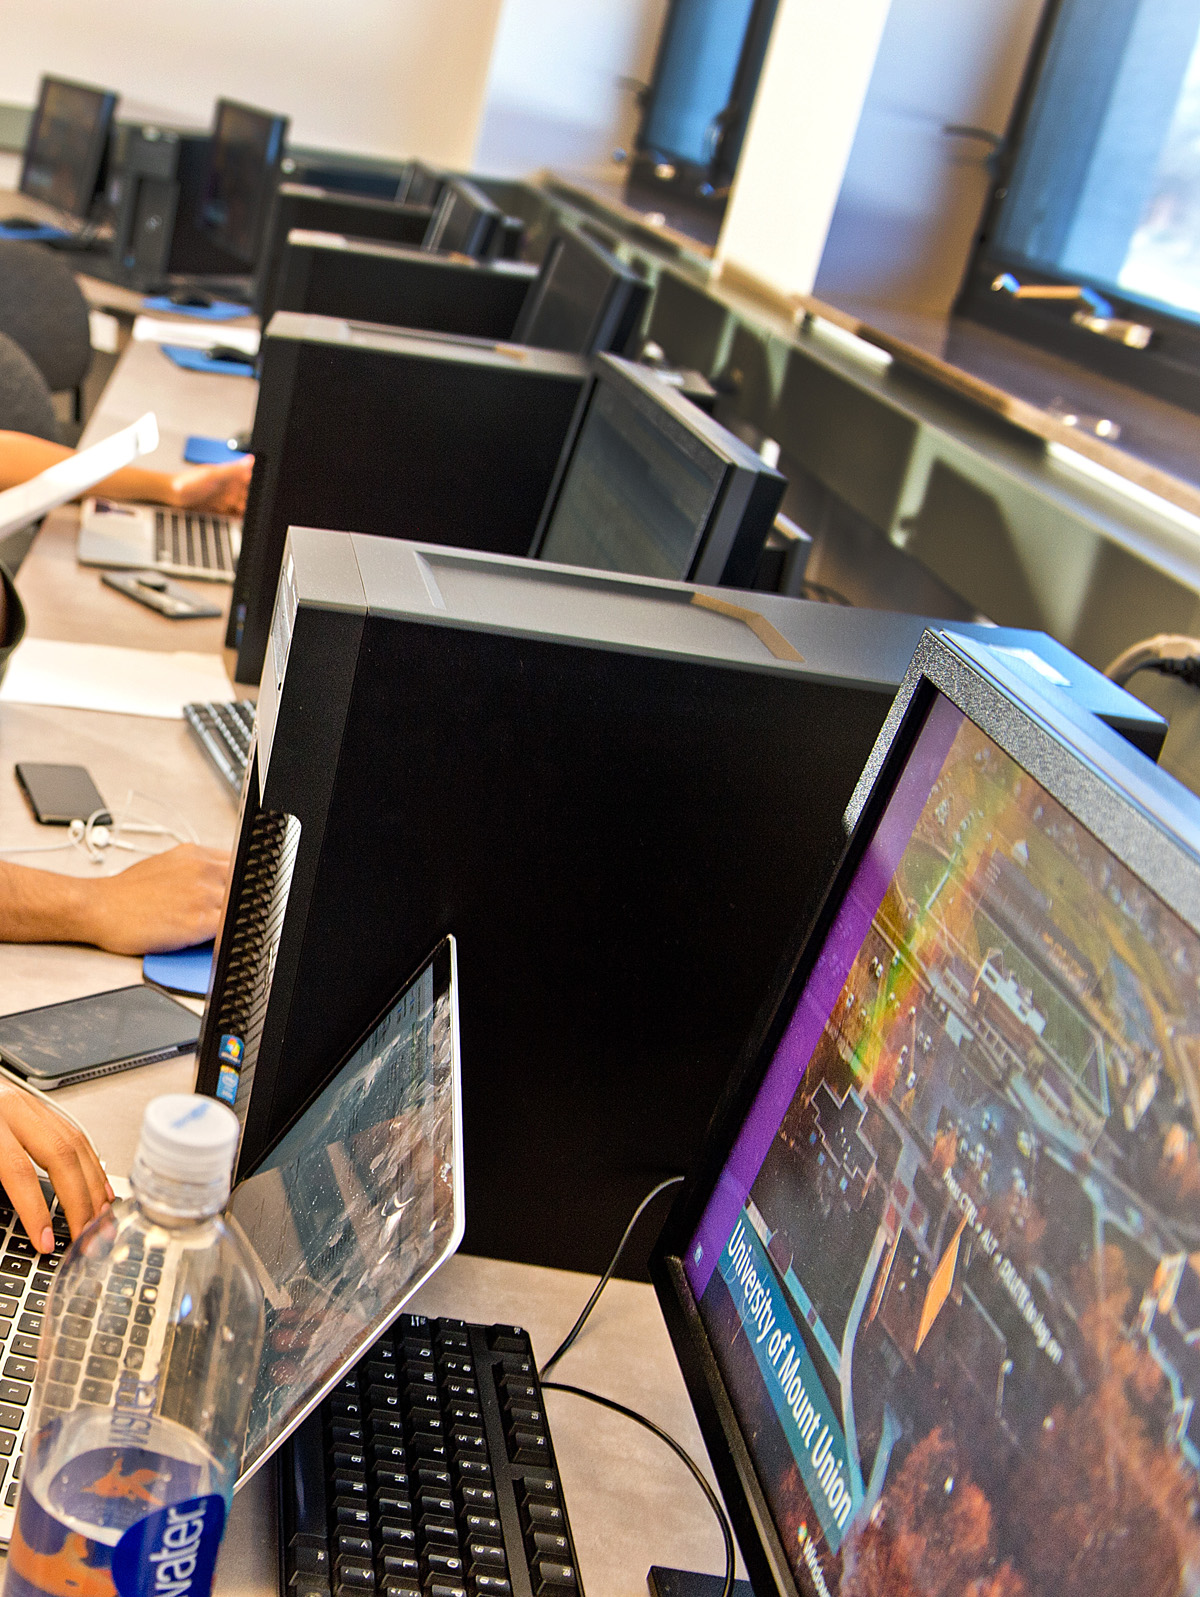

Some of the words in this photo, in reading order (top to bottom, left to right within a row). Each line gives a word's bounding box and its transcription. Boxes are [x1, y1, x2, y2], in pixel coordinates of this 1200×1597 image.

[728, 1219, 776, 1343] University
[959, 1193, 977, 1227] CTRL
[980, 1228, 999, 1255] ALT
[1000, 1258, 1030, 1310] DELETE
[1023, 1301, 1037, 1325] to
[1032, 1313, 1051, 1349] log
[1045, 1339, 1063, 1365] on
[768, 1328, 791, 1364] of
[424, 1373, 433, 1381] W
[778, 1346, 821, 1449] Mount
[390, 1421, 400, 1429] F
[811, 1425, 851, 1529] Union
[401, 1530, 413, 1539] K
[448, 1559, 459, 1568] O
